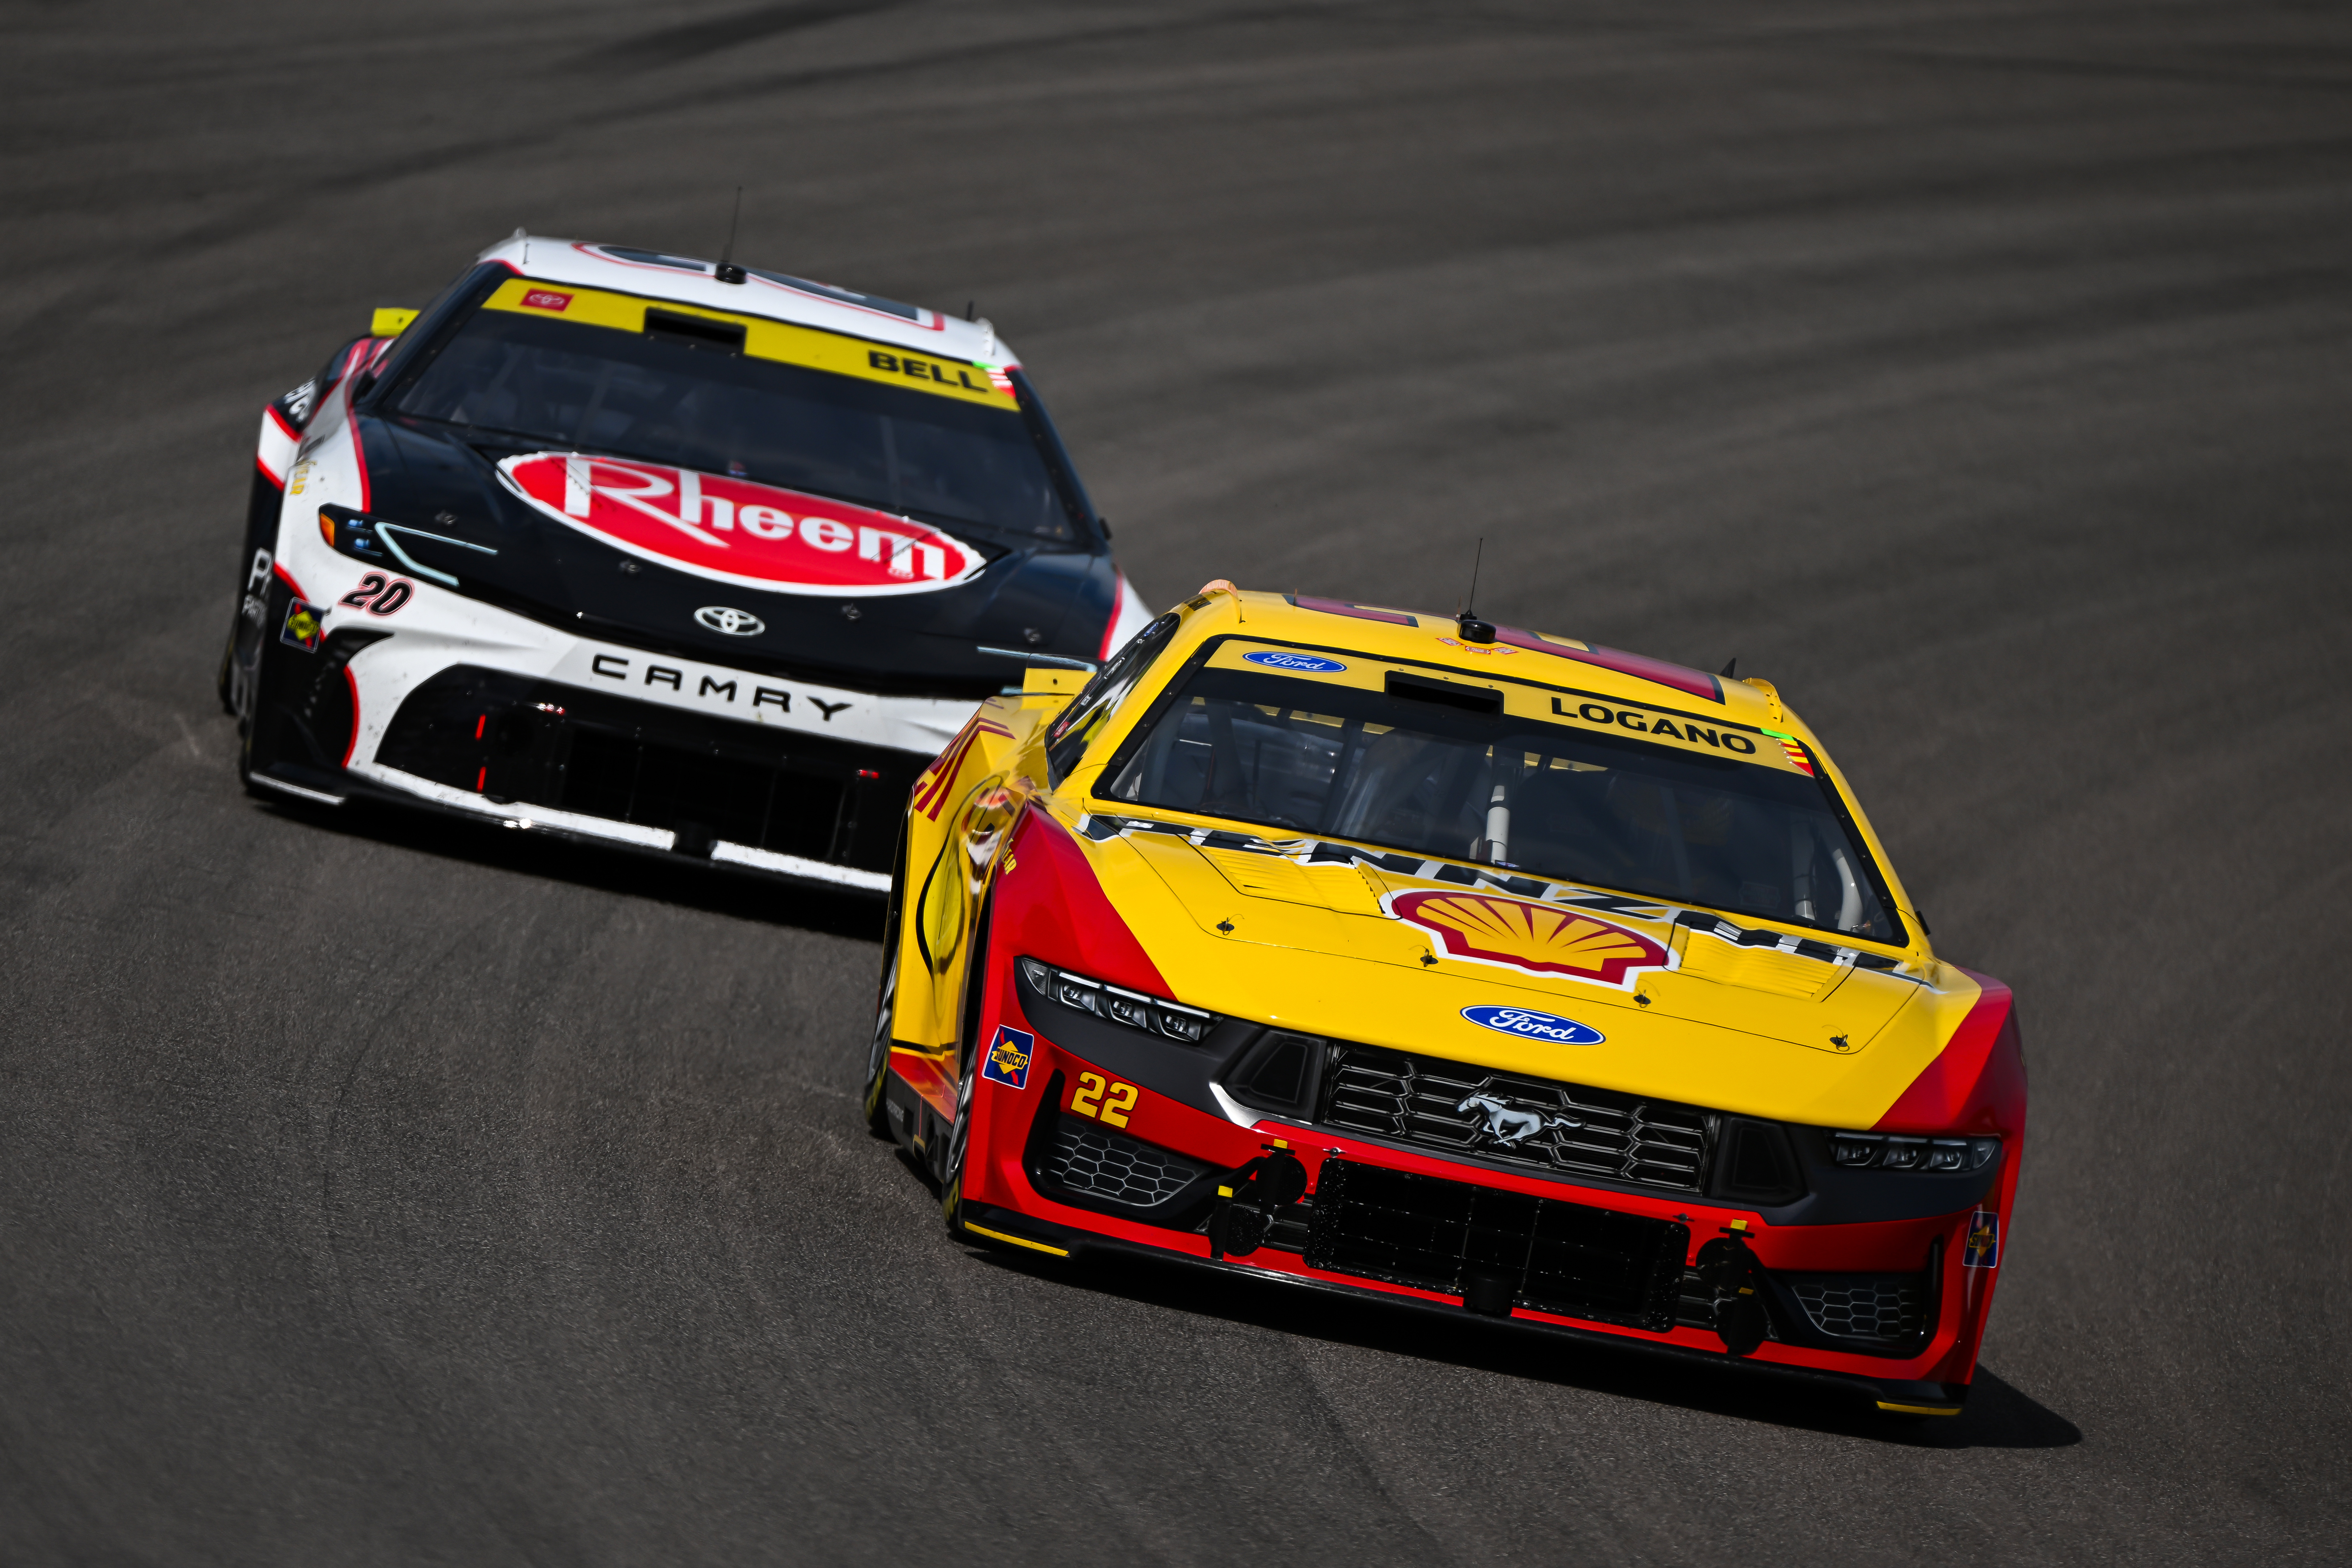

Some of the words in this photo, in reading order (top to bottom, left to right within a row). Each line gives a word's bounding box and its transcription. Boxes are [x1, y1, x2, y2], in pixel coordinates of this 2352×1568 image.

[870, 351, 987, 392] BELL
[564, 457, 943, 579] Rheem
[338, 572, 414, 616] 20
[1263, 653, 1325, 670] Ford
[593, 654, 852, 721] CAMRY
[1552, 697, 1755, 755] LOGANO
[1489, 1010, 1576, 1040] Ford
[995, 1048, 1027, 1068] SUNOCO
[1071, 1072, 1139, 1129] 22
